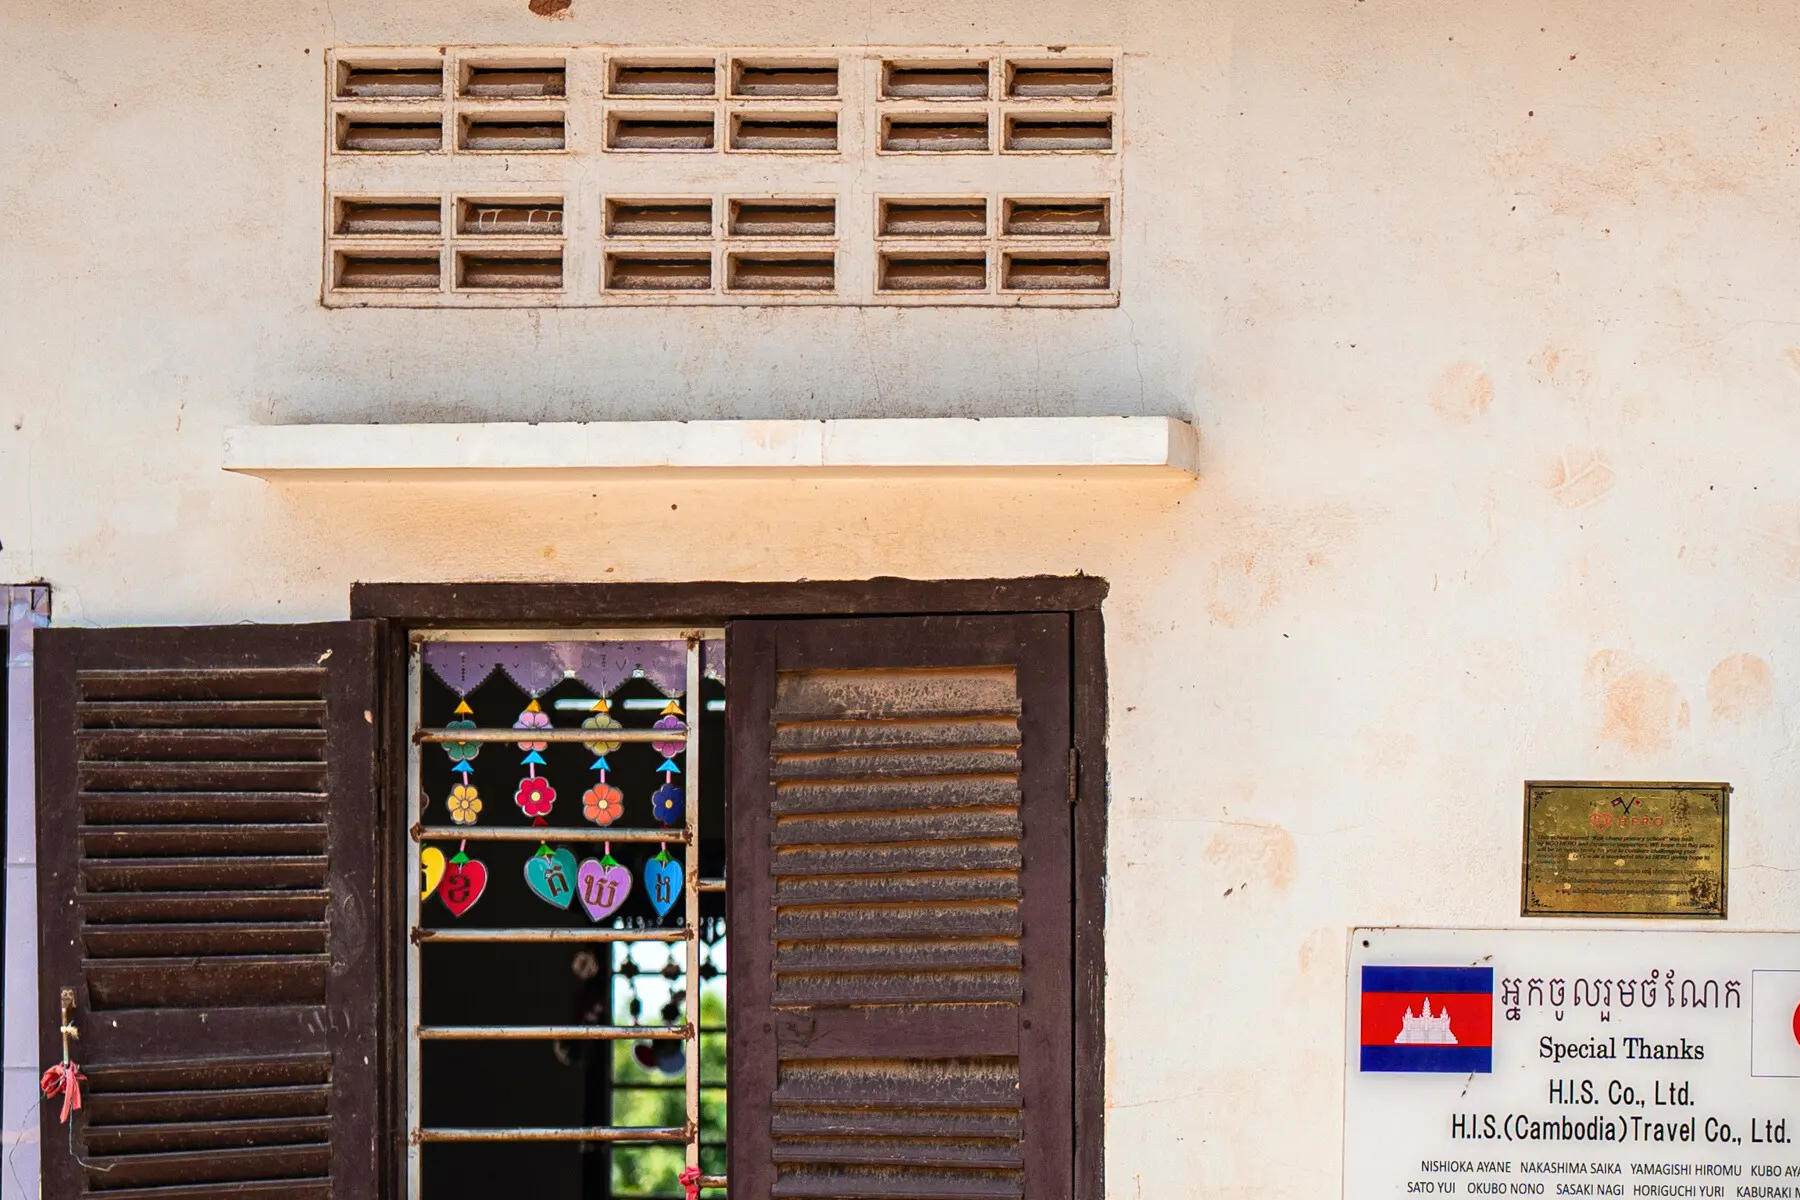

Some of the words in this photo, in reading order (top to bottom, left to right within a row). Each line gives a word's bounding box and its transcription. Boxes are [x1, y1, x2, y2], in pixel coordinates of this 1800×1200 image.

[448, 873, 471, 903] ខ
[584, 874, 618, 908] ឃ
[1539, 1036, 1617, 1062] Special
[1623, 1037, 1705, 1060] Thanks
[1549, 1079, 1599, 1105] H.I.S.
[1608, 1079, 1645, 1108] Co.,
[1655, 1080, 1695, 1106] Ltd.
[1704, 1118, 1743, 1146] Co.,
[1750, 1119, 1791, 1145] Ltd.
[1421, 1160, 1474, 1173] NISHIOKA
[1476, 1160, 1511, 1173] AYANE
[1520, 1161, 1588, 1174] NAKASHIMA
[1590, 1162, 1622, 1175] SAIKA
[1630, 1162, 1691, 1176] YAMAGISHI
[1695, 1163, 1742, 1177] HIROMU
[1751, 1164, 1782, 1177] KUBO
[1407, 1181, 1435, 1194] SATO
[1437, 1181, 1455, 1194] YUI
[1467, 1181, 1507, 1195] OKUBO
[1510, 1182, 1544, 1195] NONO
[1556, 1183, 1593, 1196] SASAKI
[1595, 1183, 1624, 1196] NAGI
[1633, 1184, 1696, 1197] HORIGUCHI
[1699, 1185, 1724, 1198] YURI
[1737, 1185, 1791, 1199] KABURAKI
